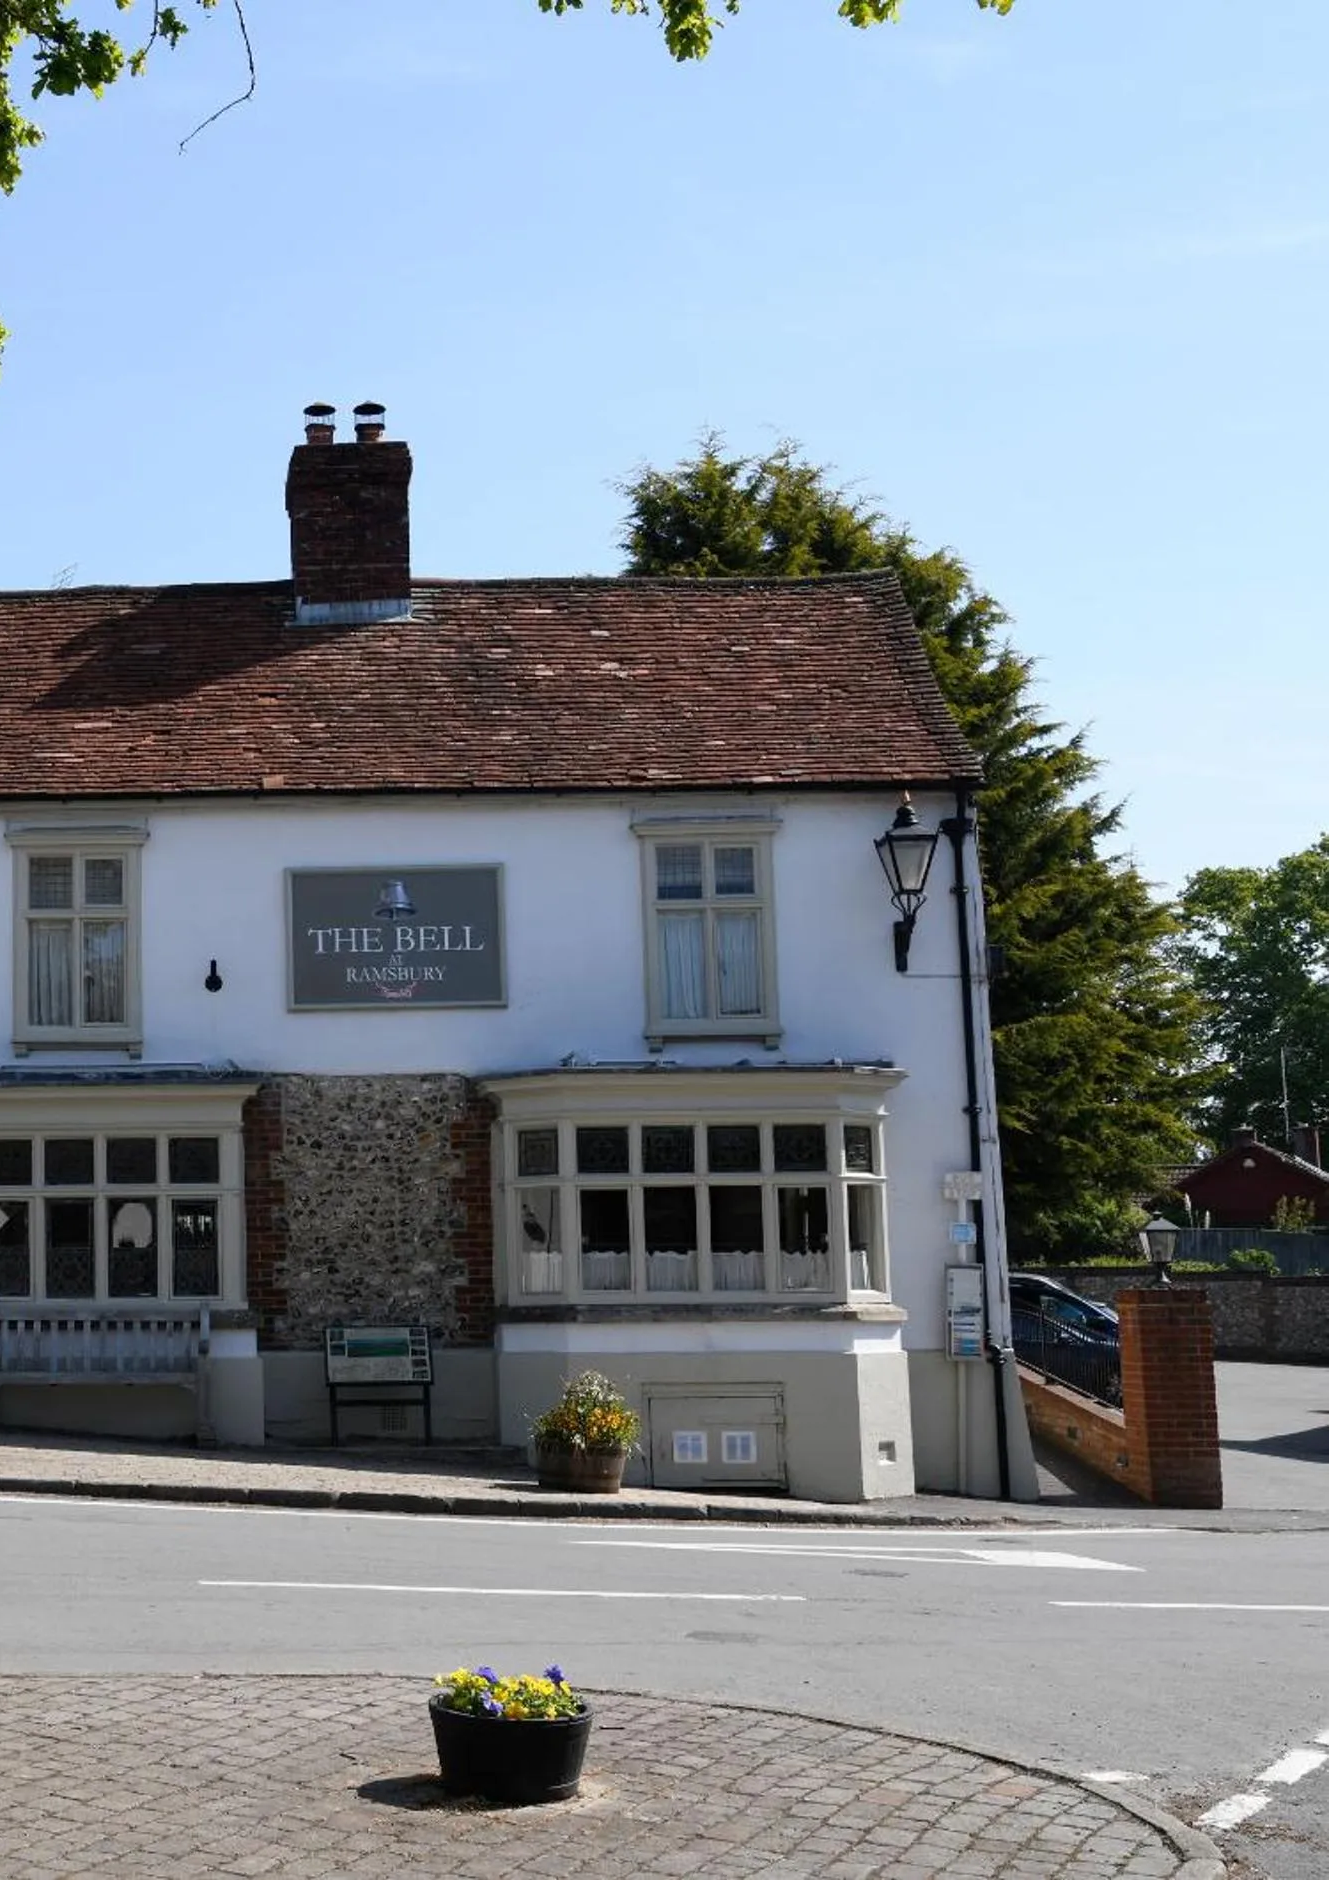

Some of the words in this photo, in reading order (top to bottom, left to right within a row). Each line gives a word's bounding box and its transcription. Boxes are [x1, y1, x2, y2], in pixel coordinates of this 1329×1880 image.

[308, 928, 384, 954] THE
[393, 926, 485, 952] BELL
[389, 954, 403, 966] AT
[345, 966, 447, 982] RAMSBURY
